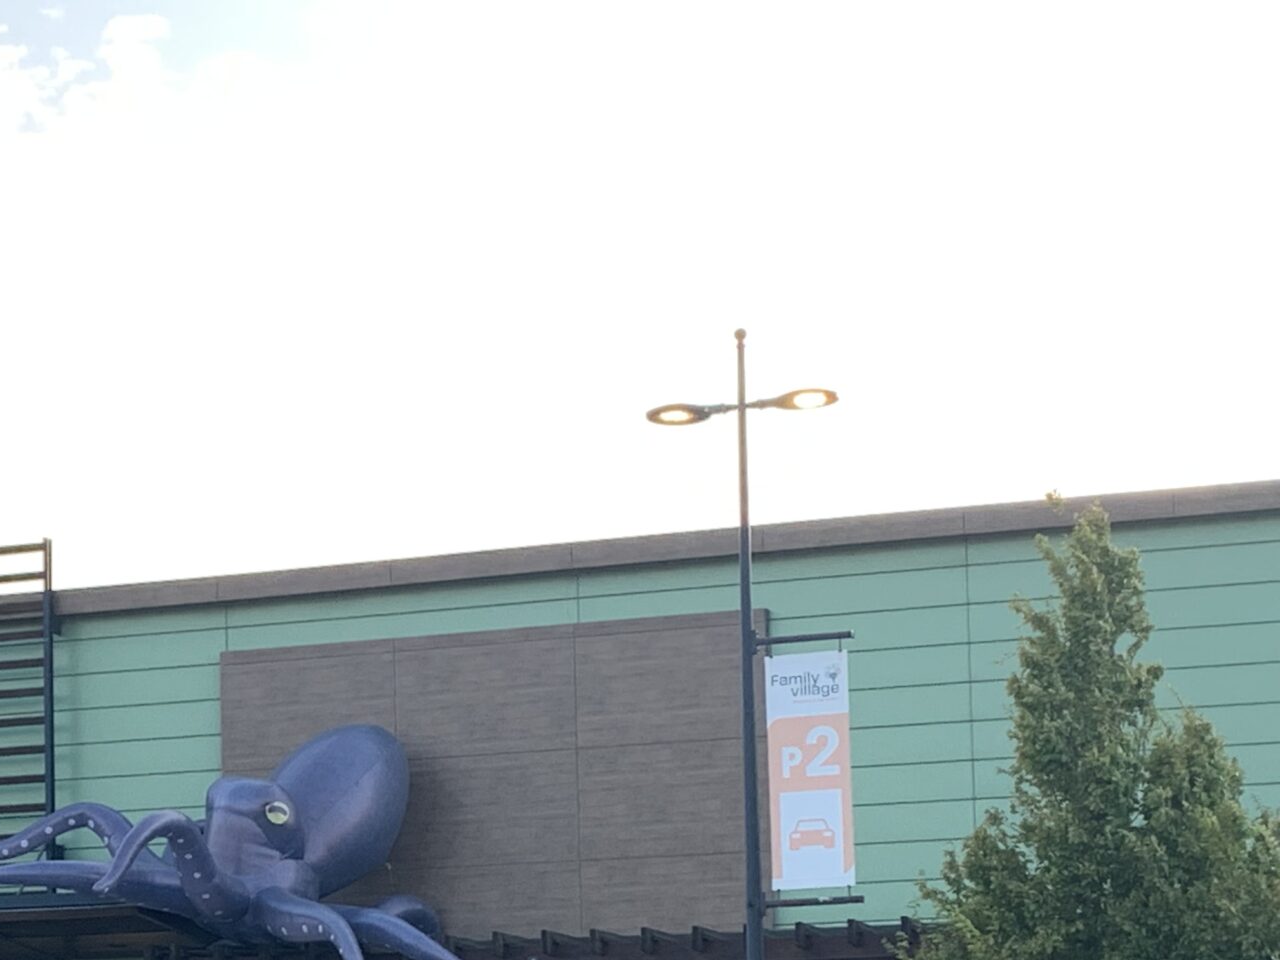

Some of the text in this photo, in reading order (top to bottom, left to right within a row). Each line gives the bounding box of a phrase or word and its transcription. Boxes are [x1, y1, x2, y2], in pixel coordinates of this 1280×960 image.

[770, 671, 820, 686] Family
[791, 682, 839, 697] village
[781, 725, 840, 779] P2
